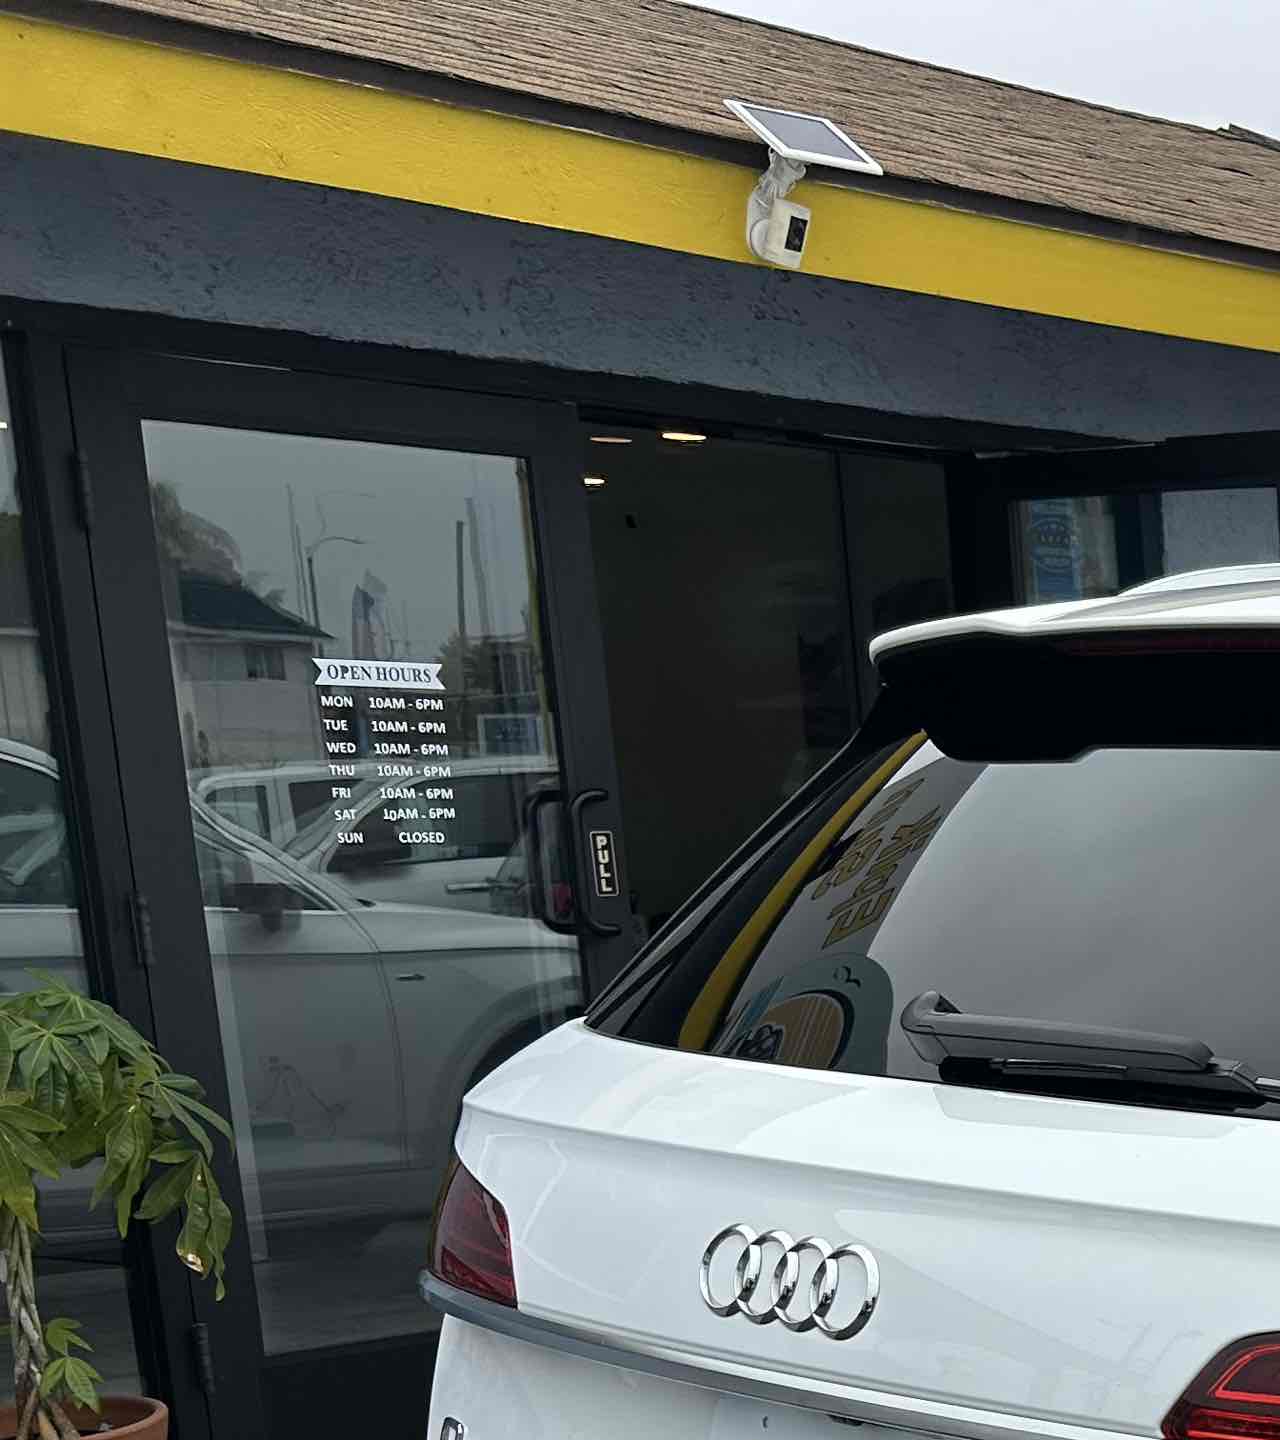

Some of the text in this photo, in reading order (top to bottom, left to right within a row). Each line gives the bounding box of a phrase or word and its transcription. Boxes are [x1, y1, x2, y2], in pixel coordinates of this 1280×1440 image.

[327, 664, 432, 684] OPEN HOURS
[320, 695, 354, 708] MON
[368, 697, 406, 710] 10AM
[415, 698, 444, 711] 6PM
[323, 718, 349, 732] TUE
[370, 720, 408, 733] 10AM
[417, 722, 447, 734] 6PM
[326, 742, 357, 754] WED
[374, 743, 410, 755] 10AM
[420, 744, 449, 756] 6PM
[328, 764, 355, 776] THU
[377, 765, 414, 777] 10AM
[423, 766, 451, 777] 6PM
[331, 787, 351, 799] FRI
[380, 787, 416, 800] 10AM
[426, 788, 453, 800] 6PM
[334, 808, 358, 821] SAT
[383, 808, 418, 822] 10AM
[428, 807, 456, 819] 6PM
[337, 831, 445, 844] SUN CLOSED
[596, 835, 613, 892] PULL
